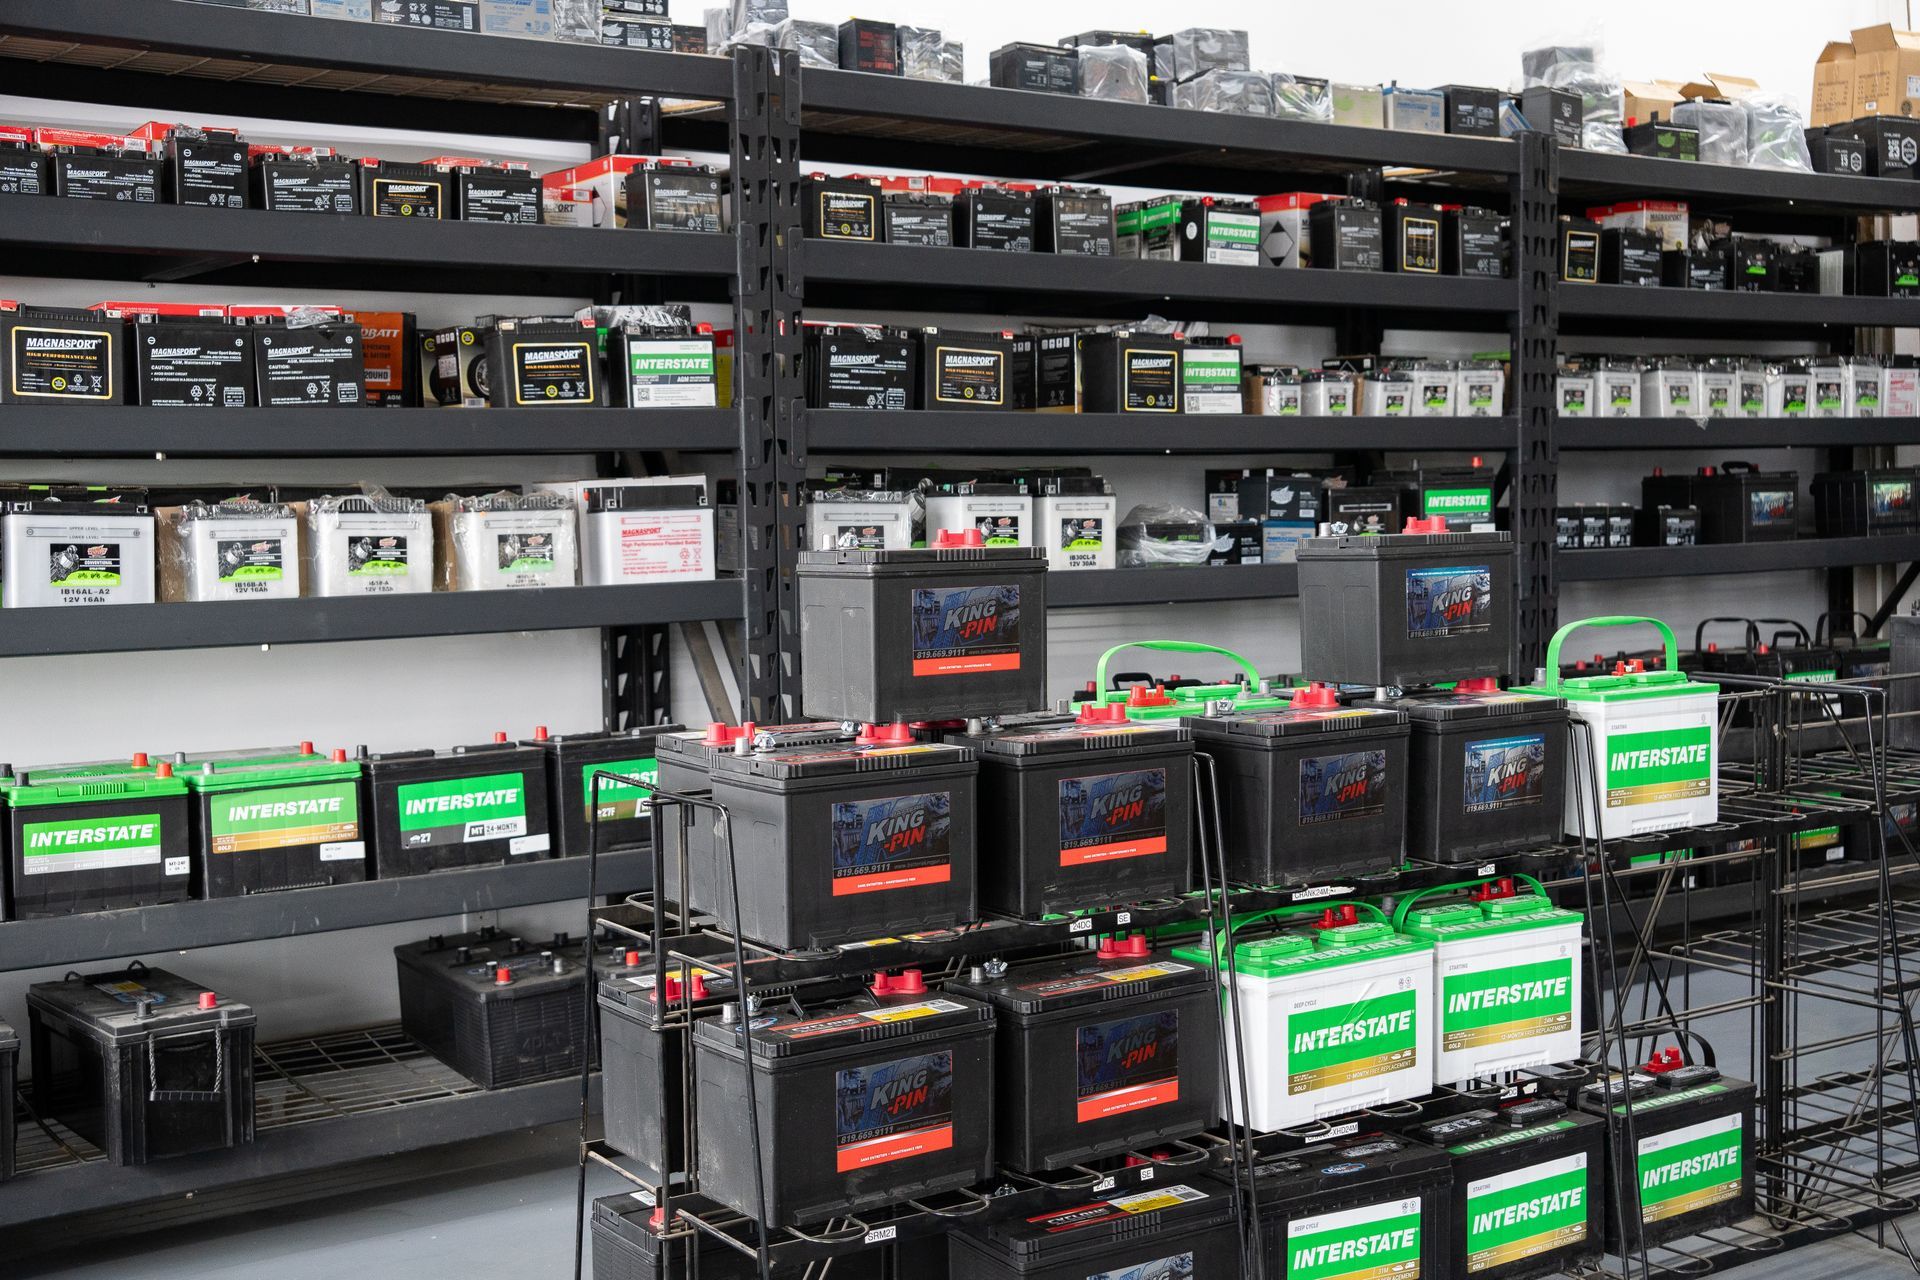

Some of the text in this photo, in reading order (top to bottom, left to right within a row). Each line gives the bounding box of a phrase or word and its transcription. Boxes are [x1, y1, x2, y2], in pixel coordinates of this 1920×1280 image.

[67, 170, 108, 178] MAGNASPORT
[388, 184, 428, 193] MAGNASPORT
[468, 190, 505, 198] MAGNASPORT
[1210, 226, 1258, 239] INTERSTATE
[26, 338, 98, 350] MAGNASPORT
[151, 348, 198, 358] MAGNASPORT
[268, 348, 312, 358] MAGNASPORT
[525, 350, 580, 362] MAGNASPORT
[635, 358, 710, 370] INTERSTATE
[830, 355, 877, 365] MAGNASPORT
[945, 356, 996, 366] MAGNASPORT
[1131, 358, 1172, 368] MAGNASPORT
[1185, 367, 1237, 378] INTERSTATE
[1428, 495, 1489, 507] INTERSTATE
[621, 528, 662, 537] MAGNASPORT
[1431, 586, 1473, 614] KING
[944, 600, 997, 631] KING
[1410, 629, 1448, 638] 819.669.9111
[916, 649, 966, 659] 819.669.9111
[1611, 744, 1707, 772] INTERSTATE
[1487, 757, 1527, 787] KING
[1324, 764, 1367, 796] KING
[406, 789, 518, 815] INTERSTATE
[1091, 783, 1143, 820] KING
[1466, 802, 1502, 812] 819.669.9111
[228, 797, 340, 822] INTERSTATE
[471, 823, 518, 836] MT 24-MONTH
[867, 809, 925, 845] KING
[30, 823, 154, 848] INTERSTATE
[319, 832, 355, 840] REPLACEMENT
[420, 833, 431, 843] 27
[1064, 836, 1112, 849] 819.669.9111
[837, 863, 891, 877] 819.669.9111
[1294, 888, 1329, 900] CRANK24M
[1072, 914, 1128, 930] 24DC SE
[1434, 908, 1574, 934] INTERSTATE
[1270, 938, 1413, 966] INTERSTATE
[1448, 977, 1568, 1014] INTERSTATE
[1305, 999, 1317, 1007] CYCLE
[1294, 1009, 1412, 1054] INTERSTATE
[1536, 1023, 1567, 1035] REPLACEMENT
[1106, 1026, 1156, 1064] KING
[1347, 1070, 1370, 1080] 12-MONTH
[1380, 1060, 1412, 1073] REPLACEMENT
[870, 1068, 928, 1110] KING
[1294, 1084, 1307, 1093] GOLD
[1631, 1087, 1713, 1110] INTERSTATE
[841, 1126, 894, 1144] 819.669.9111
[1462, 1124, 1560, 1152] INTERSTATE
[1142, 1170, 1151, 1178] SE
[1642, 1146, 1738, 1190] INTERSTATE
[1047, 1208, 1110, 1225] CYCLONE
[1473, 1188, 1582, 1235] INTERSTATE
[1305, 1222, 1318, 1230] CYCLE
[868, 1228, 895, 1241] SRM27
[1294, 1228, 1416, 1270] INTERSTATE
[1520, 1246, 1542, 1255] 12-MONTH
[1553, 1234, 1582, 1247] REPLACEMENT
